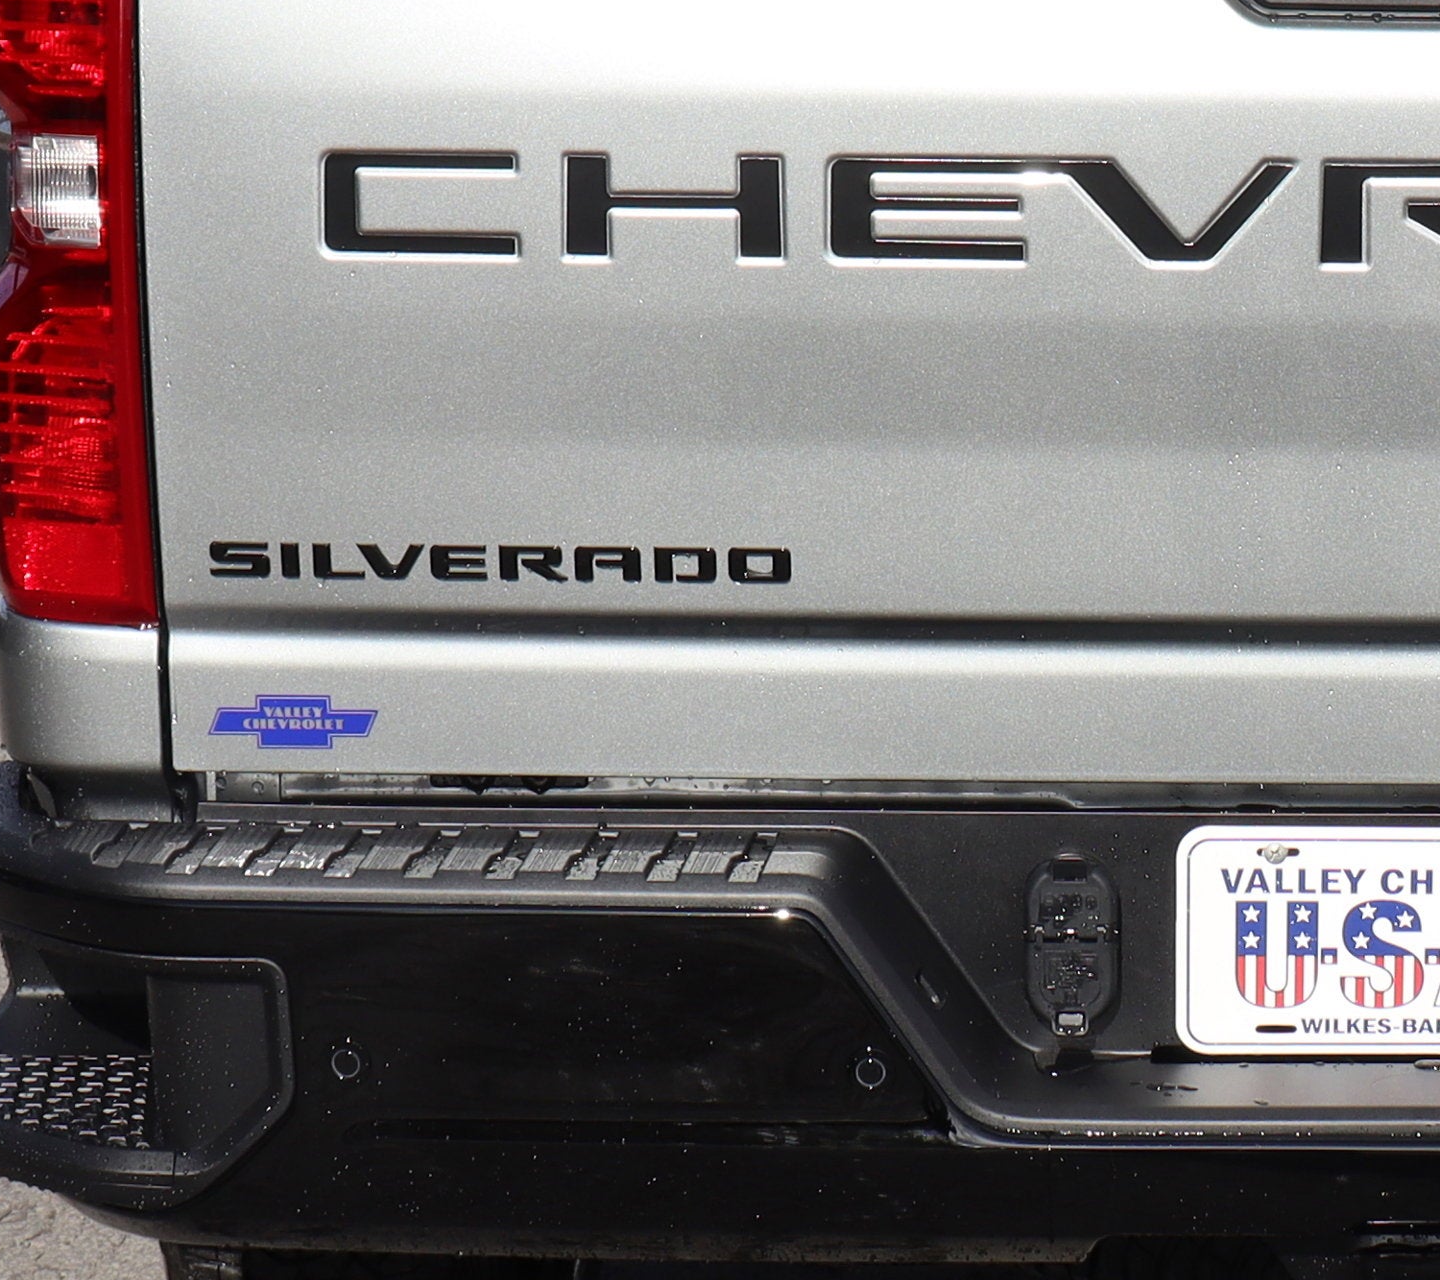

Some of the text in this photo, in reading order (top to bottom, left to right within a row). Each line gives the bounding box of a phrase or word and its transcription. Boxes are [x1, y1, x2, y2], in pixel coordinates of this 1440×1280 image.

[208, 538, 793, 585] SILVERADO
[262, 705, 325, 719] VALLEY
[242, 717, 345, 731] CHEVROLET
[1220, 867, 1367, 895] VALLEY
